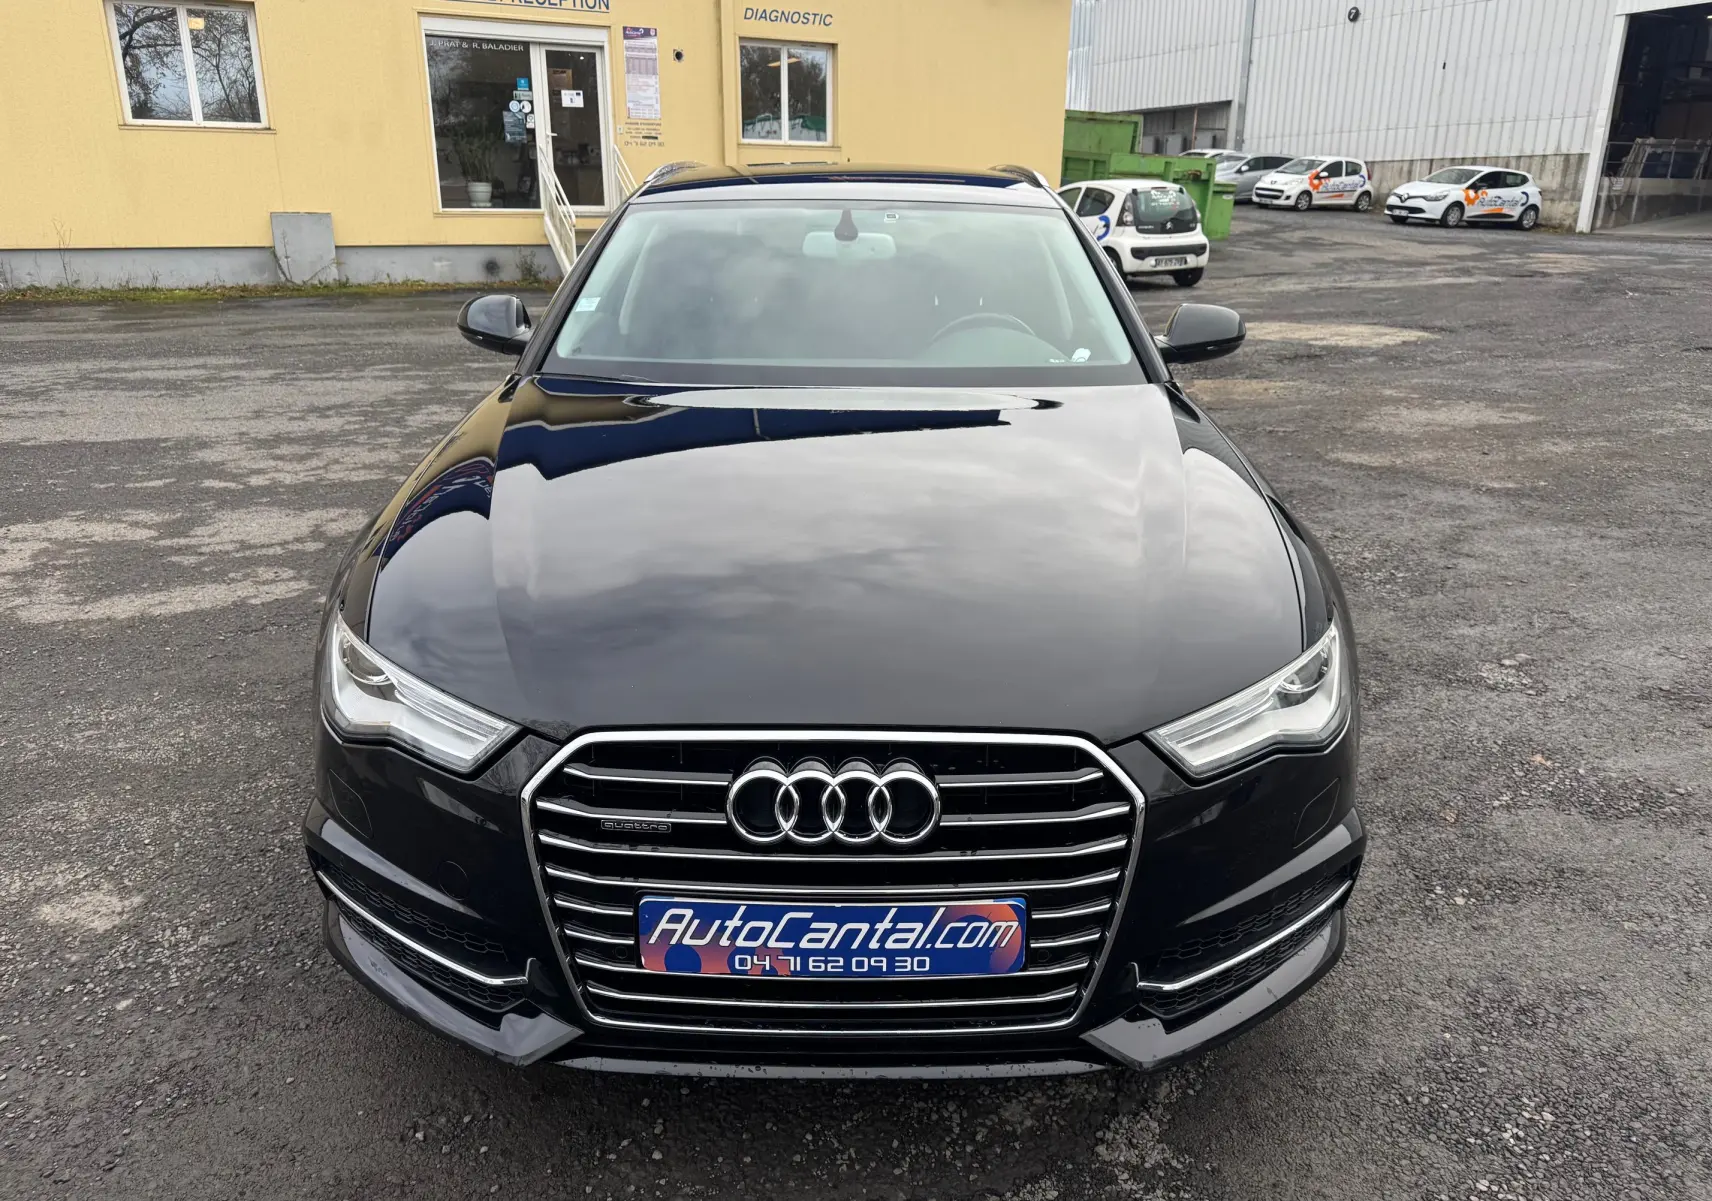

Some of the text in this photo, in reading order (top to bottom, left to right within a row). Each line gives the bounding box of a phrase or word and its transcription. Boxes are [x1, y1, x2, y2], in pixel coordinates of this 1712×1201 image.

[511, 0, 610, 10] PTION
[743, 7, 833, 27] DIAGNOSTIC
[438, 40, 460, 48] PRAT
[482, 43, 524, 51] BALADIER
[604, 822, 668, 831] quattro
[649, 905, 1019, 949] AutoCantal.com
[734, 954, 930, 972] 04 71 62 09 30
